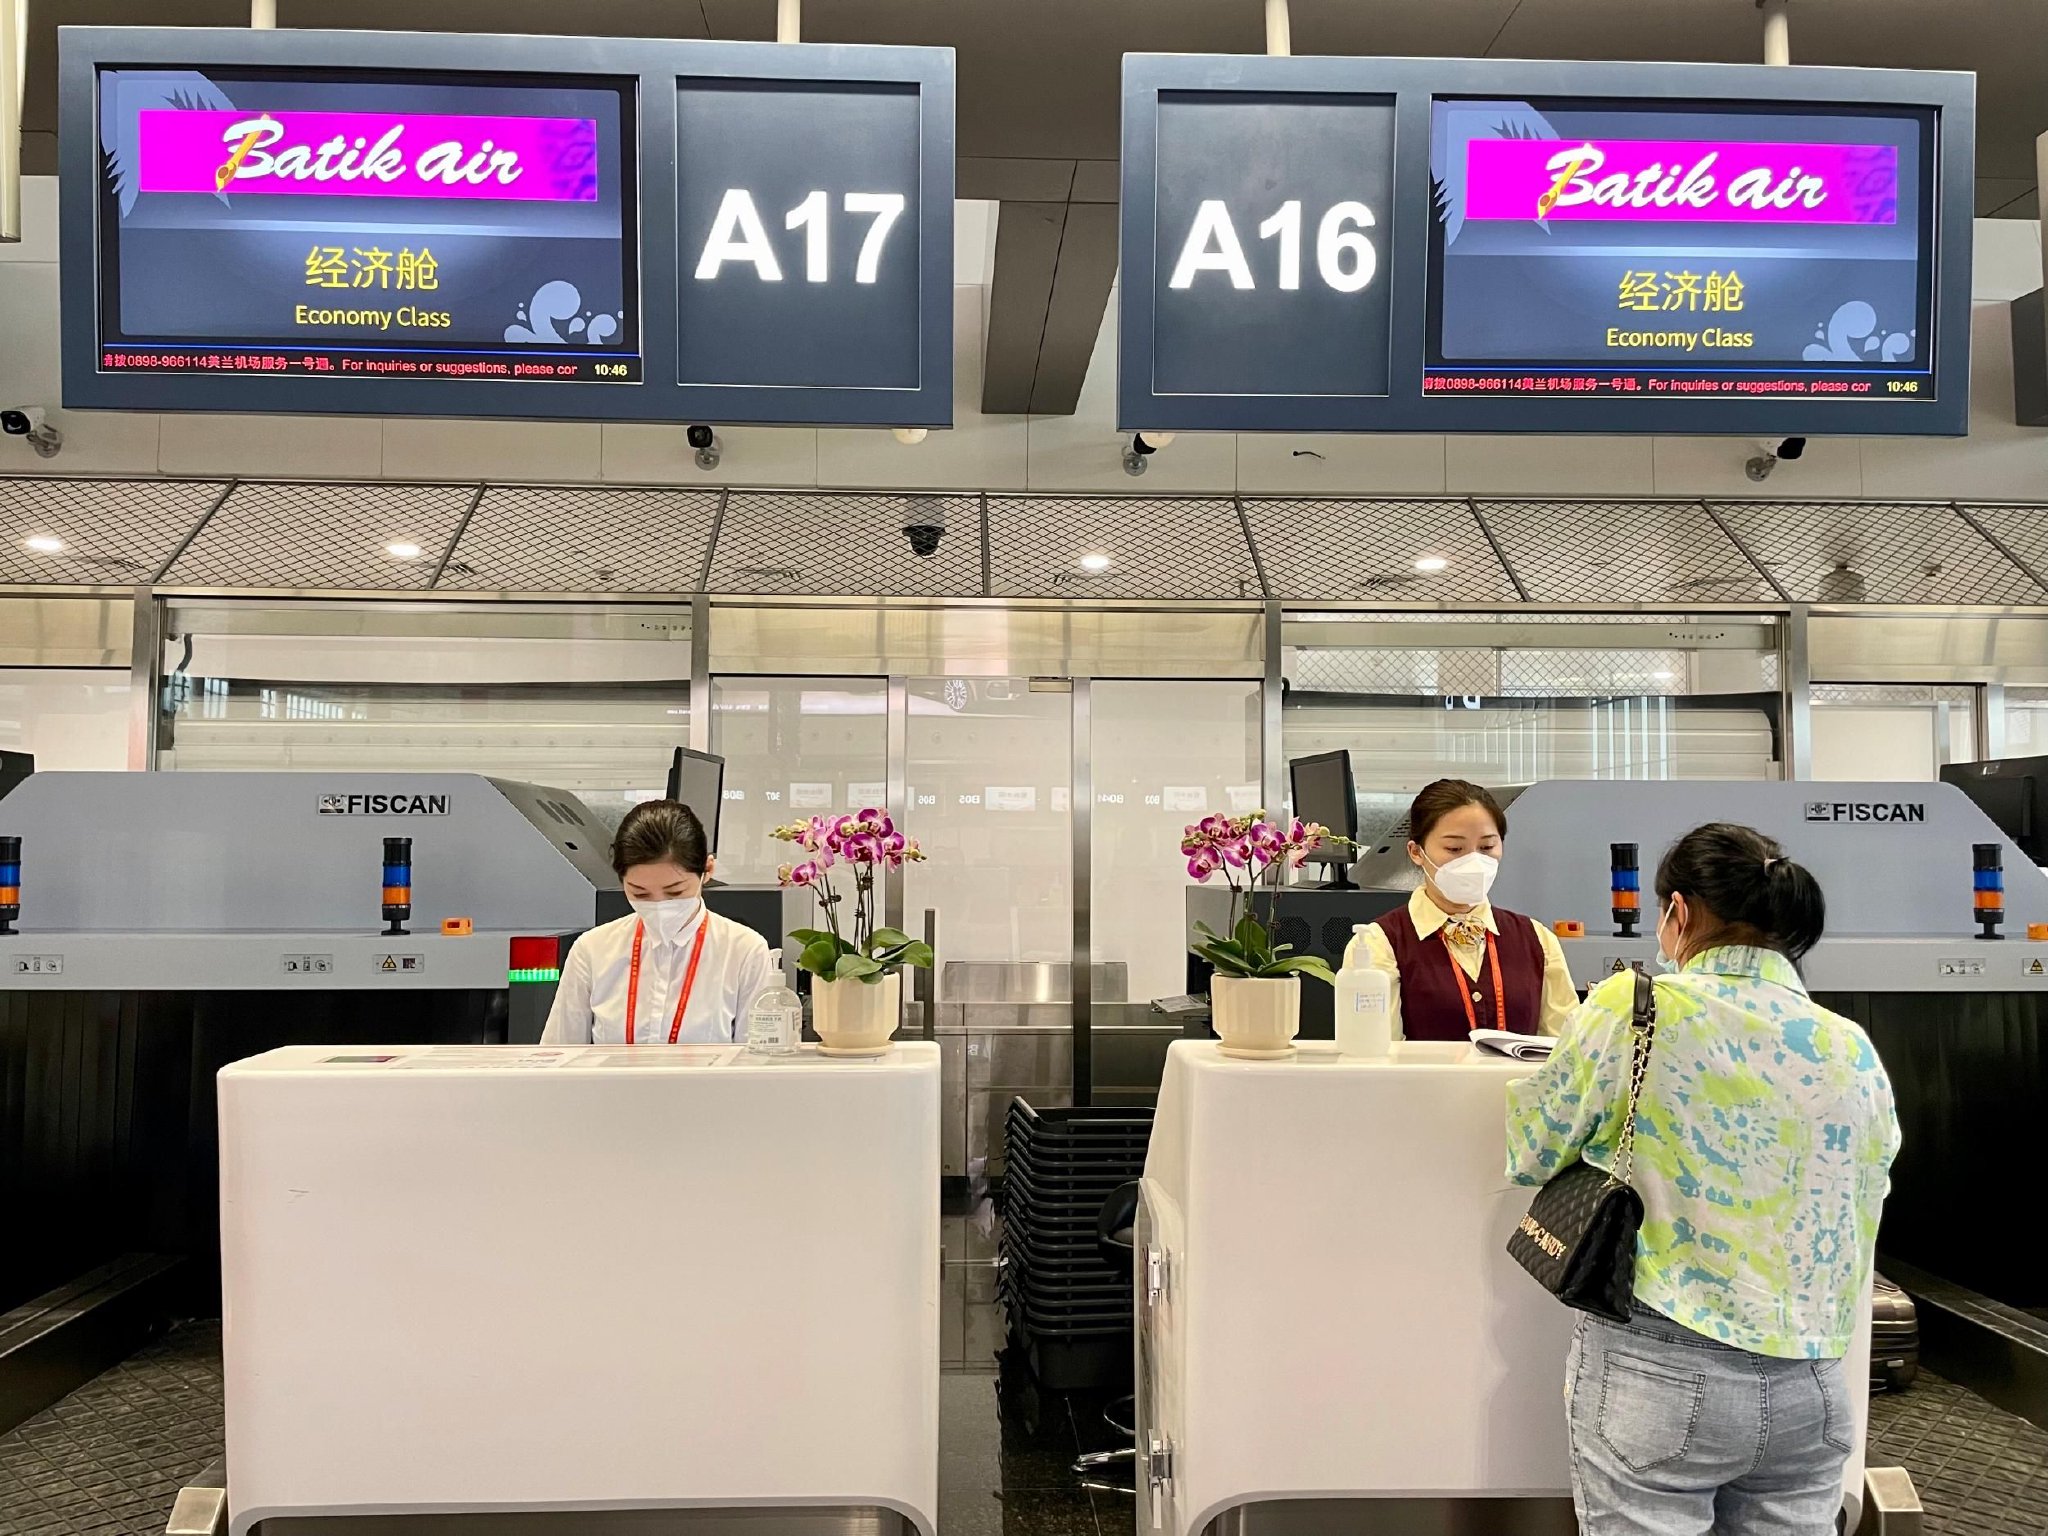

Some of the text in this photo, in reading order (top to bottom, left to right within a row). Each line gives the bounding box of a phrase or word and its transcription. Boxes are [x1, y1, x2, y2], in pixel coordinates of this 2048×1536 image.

[218, 116, 523, 186] Batik air
[1541, 144, 1828, 211] Batik air
[694, 188, 906, 284] A17
[1169, 199, 1378, 293] A16
[305, 246, 440, 291] 经济舱
[1618, 269, 1745, 313] 经济舱
[295, 304, 451, 329] Economy Class
[1606, 327, 1753, 352] Economy Class
[342, 358, 363, 371] For
[366, 360, 417, 373] inquiries
[419, 363, 433, 372] or
[435, 361, 511, 376] suggestions,
[514, 363, 555, 376] please
[594, 364, 628, 377] 10:46
[1648, 378, 1668, 391] For
[1670, 379, 1719, 392] inquiries
[1721, 381, 1735, 391] or
[1736, 380, 1808, 394] suggestions,
[1811, 381, 1849, 393] please
[1886, 381, 1918, 393] 10:46
[347, 794, 446, 814] FISCAN
[1833, 803, 1925, 822] FISCAN
